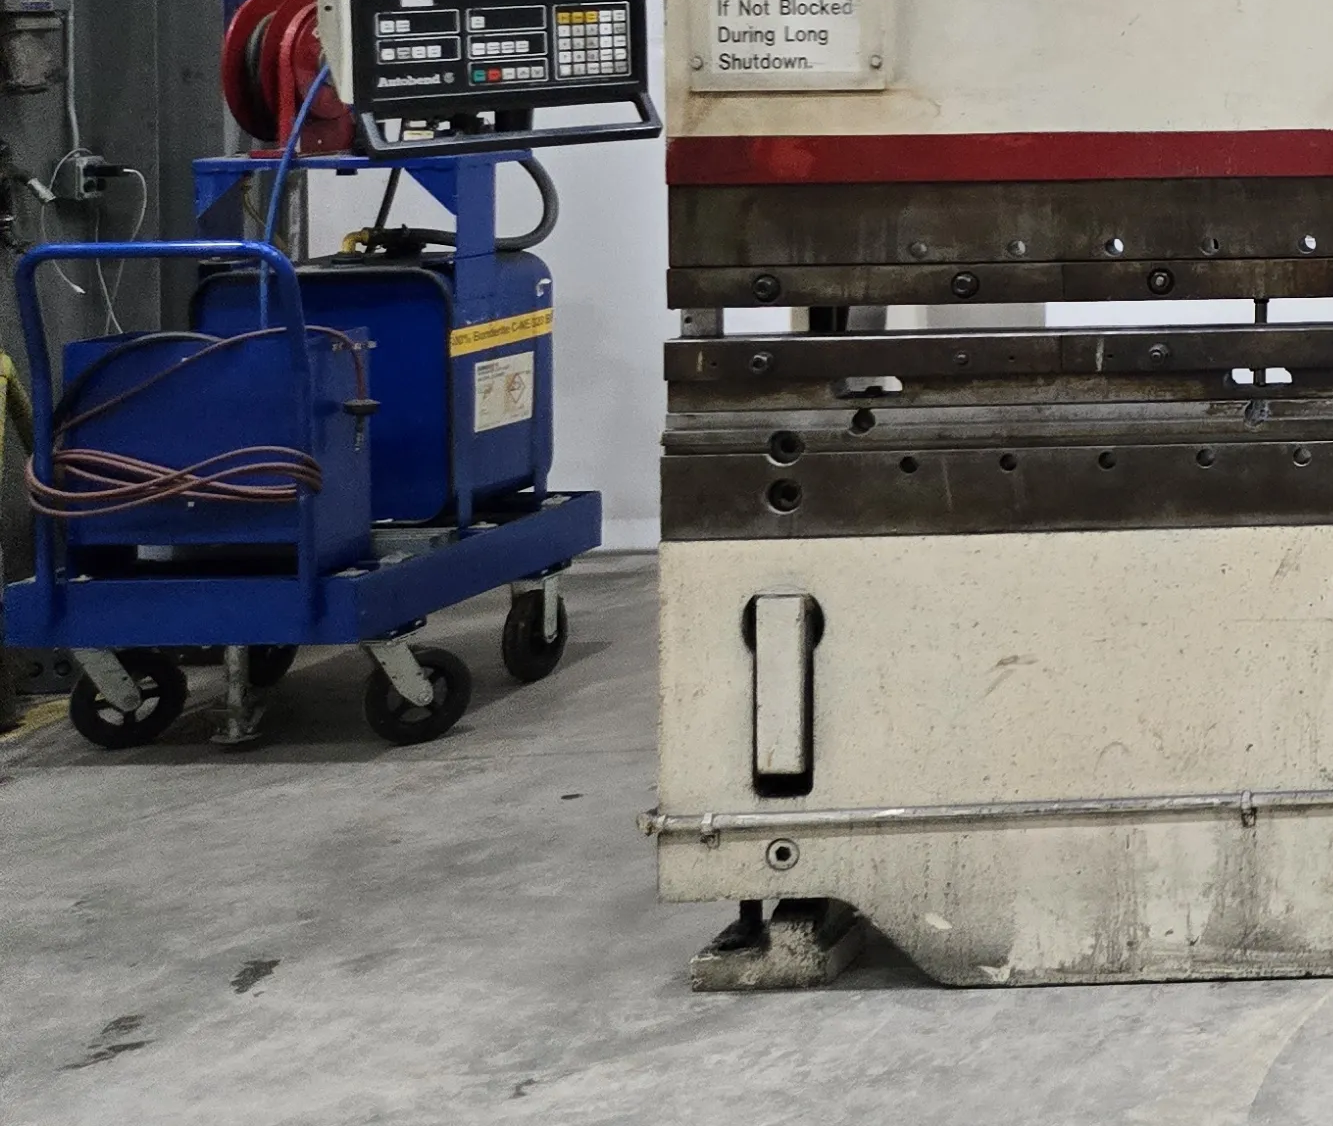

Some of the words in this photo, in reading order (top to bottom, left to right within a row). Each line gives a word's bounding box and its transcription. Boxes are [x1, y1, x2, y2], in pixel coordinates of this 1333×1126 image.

[717, 0, 730, 16] If
[738, 0, 771, 16] Not
[779, 0, 854, 16] Blocked
[717, 26, 776, 46] During
[784, 26, 829, 46] Long
[718, 52, 813, 70] Shutdown.
